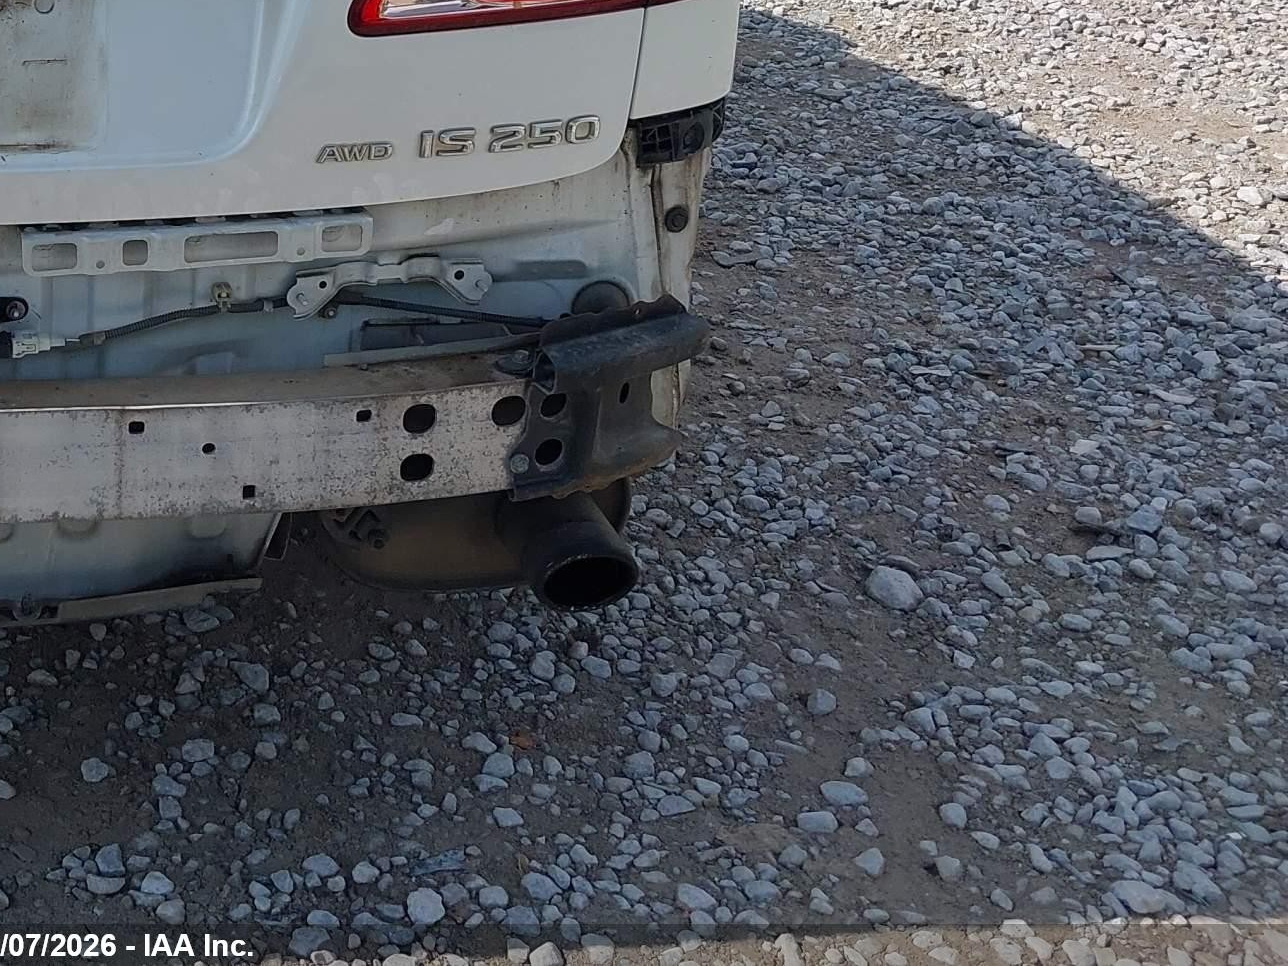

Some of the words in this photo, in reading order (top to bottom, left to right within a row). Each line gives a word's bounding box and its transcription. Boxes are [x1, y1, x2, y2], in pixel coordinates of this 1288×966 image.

[315, 142, 394, 164] AWD
[418, 127, 477, 160] IS
[487, 114, 602, 155] 250
